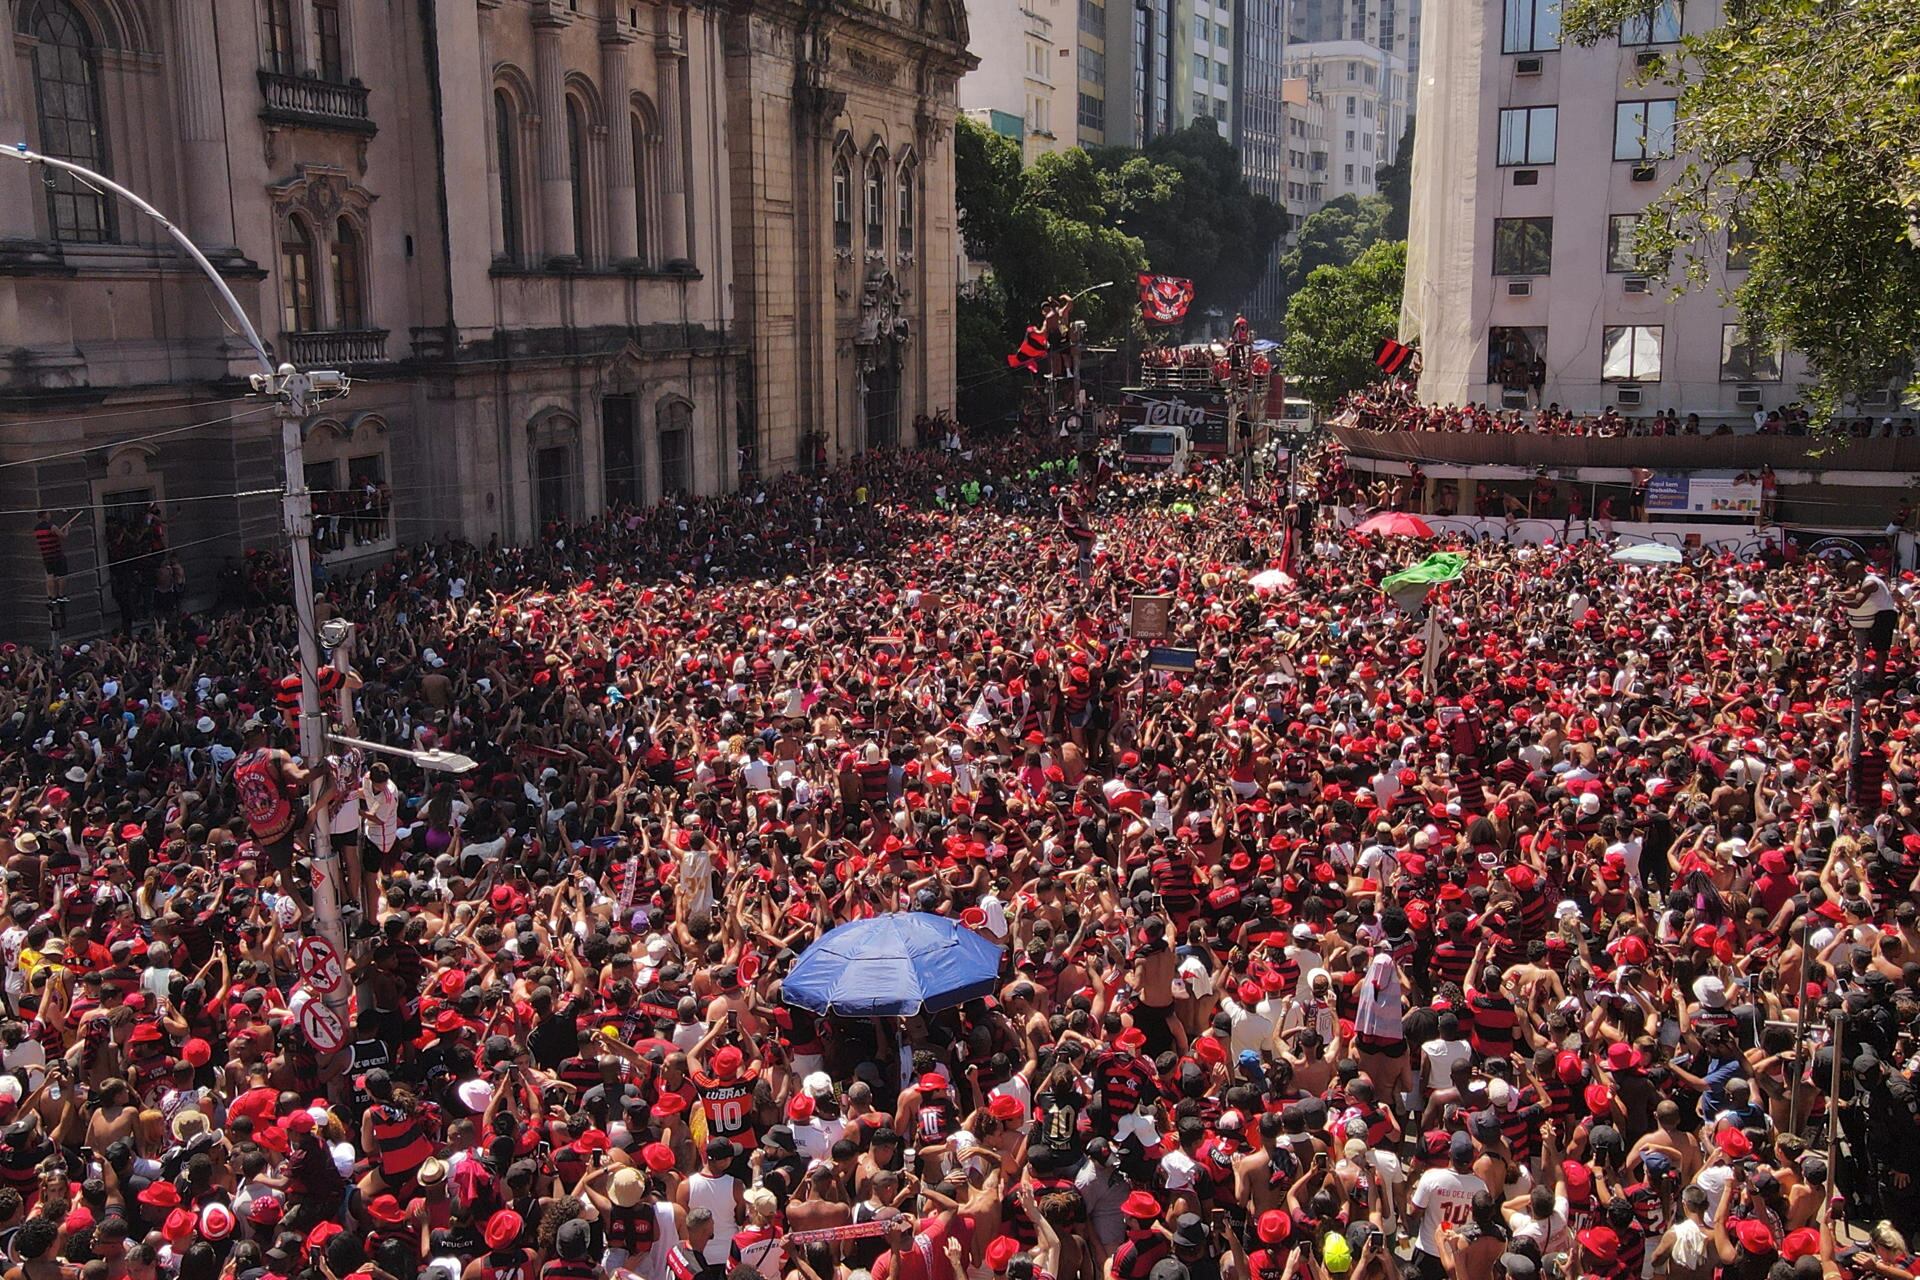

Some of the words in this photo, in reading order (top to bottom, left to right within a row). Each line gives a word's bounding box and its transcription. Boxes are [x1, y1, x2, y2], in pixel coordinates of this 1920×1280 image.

[1142, 396, 1205, 426] Tetra
[706, 1087, 747, 1100] LUBRAX
[712, 1101, 742, 1133] 10
[922, 1111, 939, 1135] 10
[1048, 1104, 1075, 1138] 10
